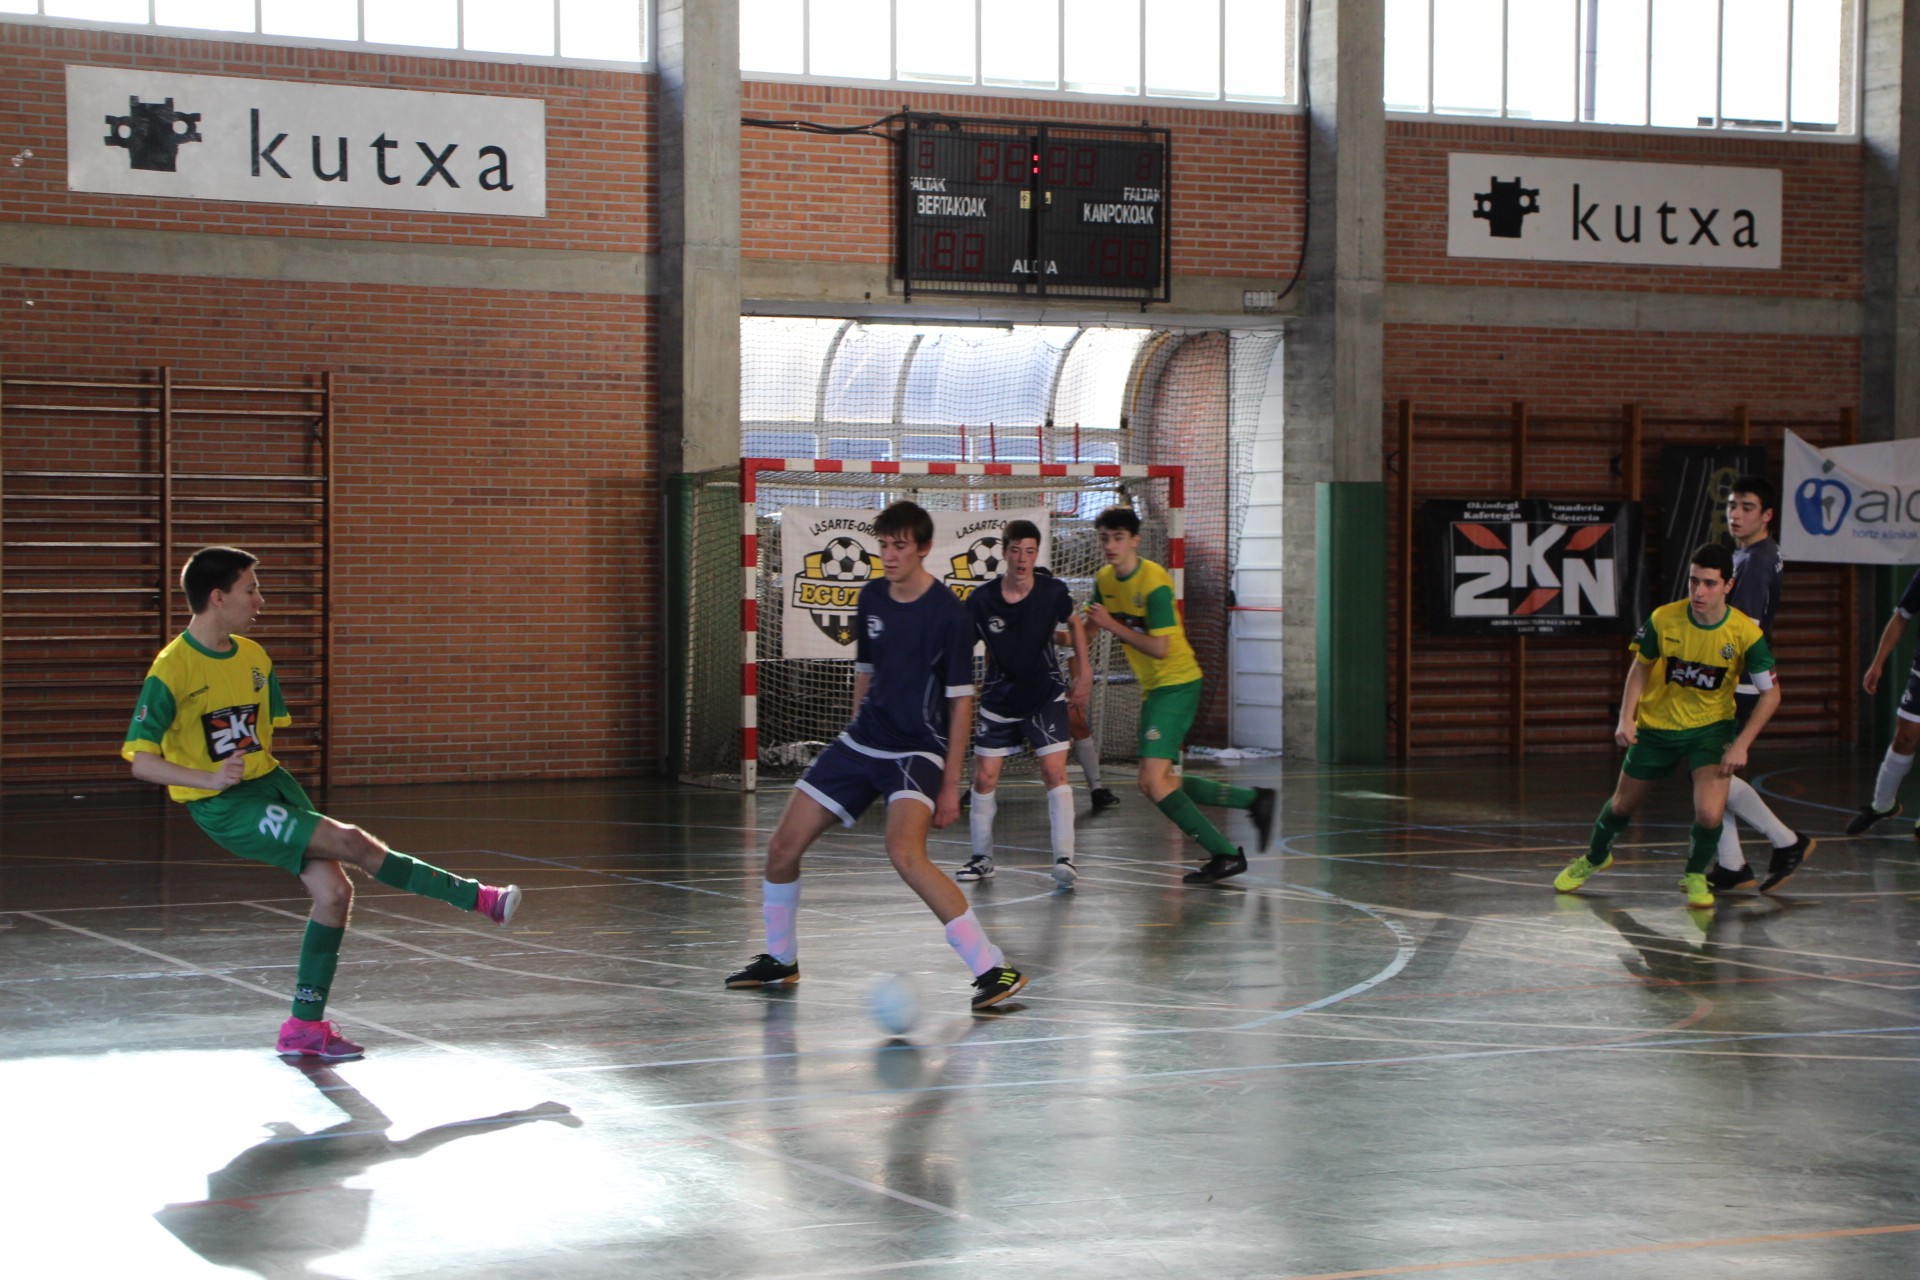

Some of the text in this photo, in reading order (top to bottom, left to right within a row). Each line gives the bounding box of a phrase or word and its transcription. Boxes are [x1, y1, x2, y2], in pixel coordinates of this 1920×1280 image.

[250, 107, 514, 191] kutxa
[917, 195, 987, 217] BERTAKOAK
[1083, 202, 1154, 225] KANPOKOAK
[1572, 183, 1759, 248] kutxa
[258, 804, 288, 840] 20
